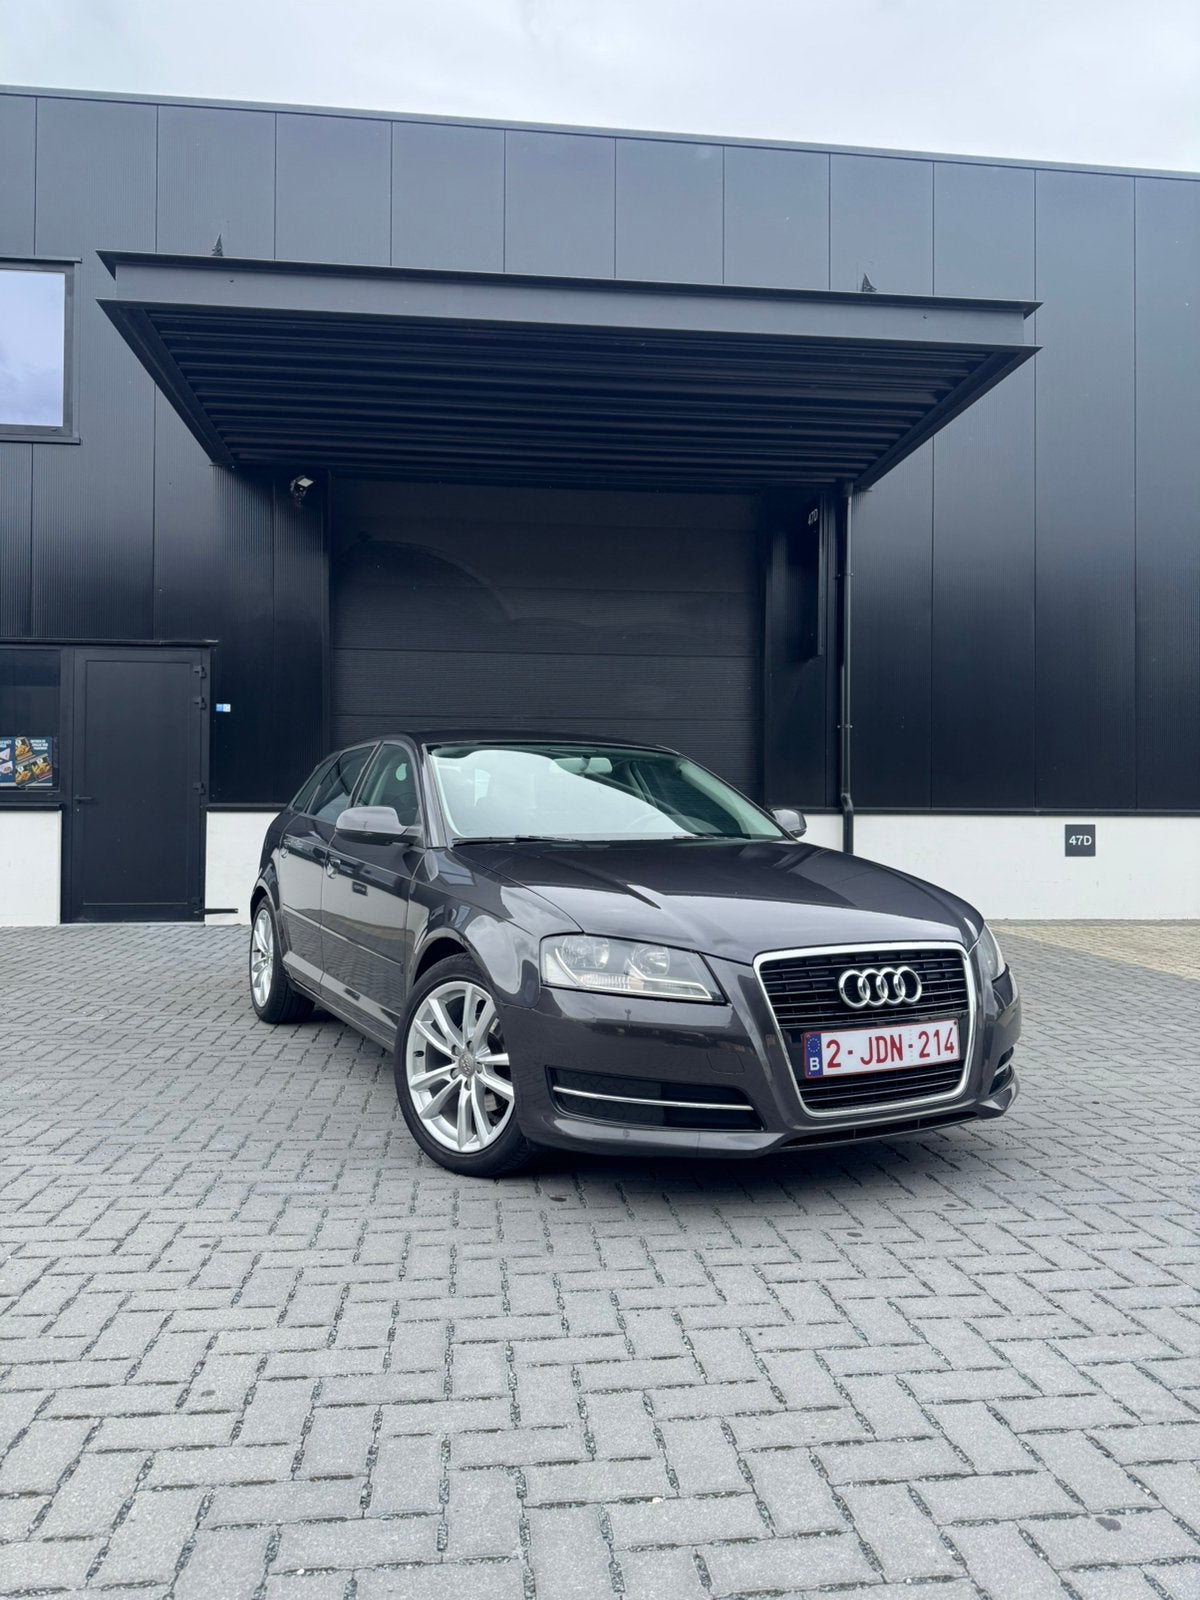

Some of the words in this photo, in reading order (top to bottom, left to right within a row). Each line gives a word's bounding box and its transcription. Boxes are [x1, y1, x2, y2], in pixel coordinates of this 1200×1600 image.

[1069, 835, 1092, 846] 47D
[826, 1027, 955, 1068] 2-JDN-214
[809, 1057, 820, 1071] B
